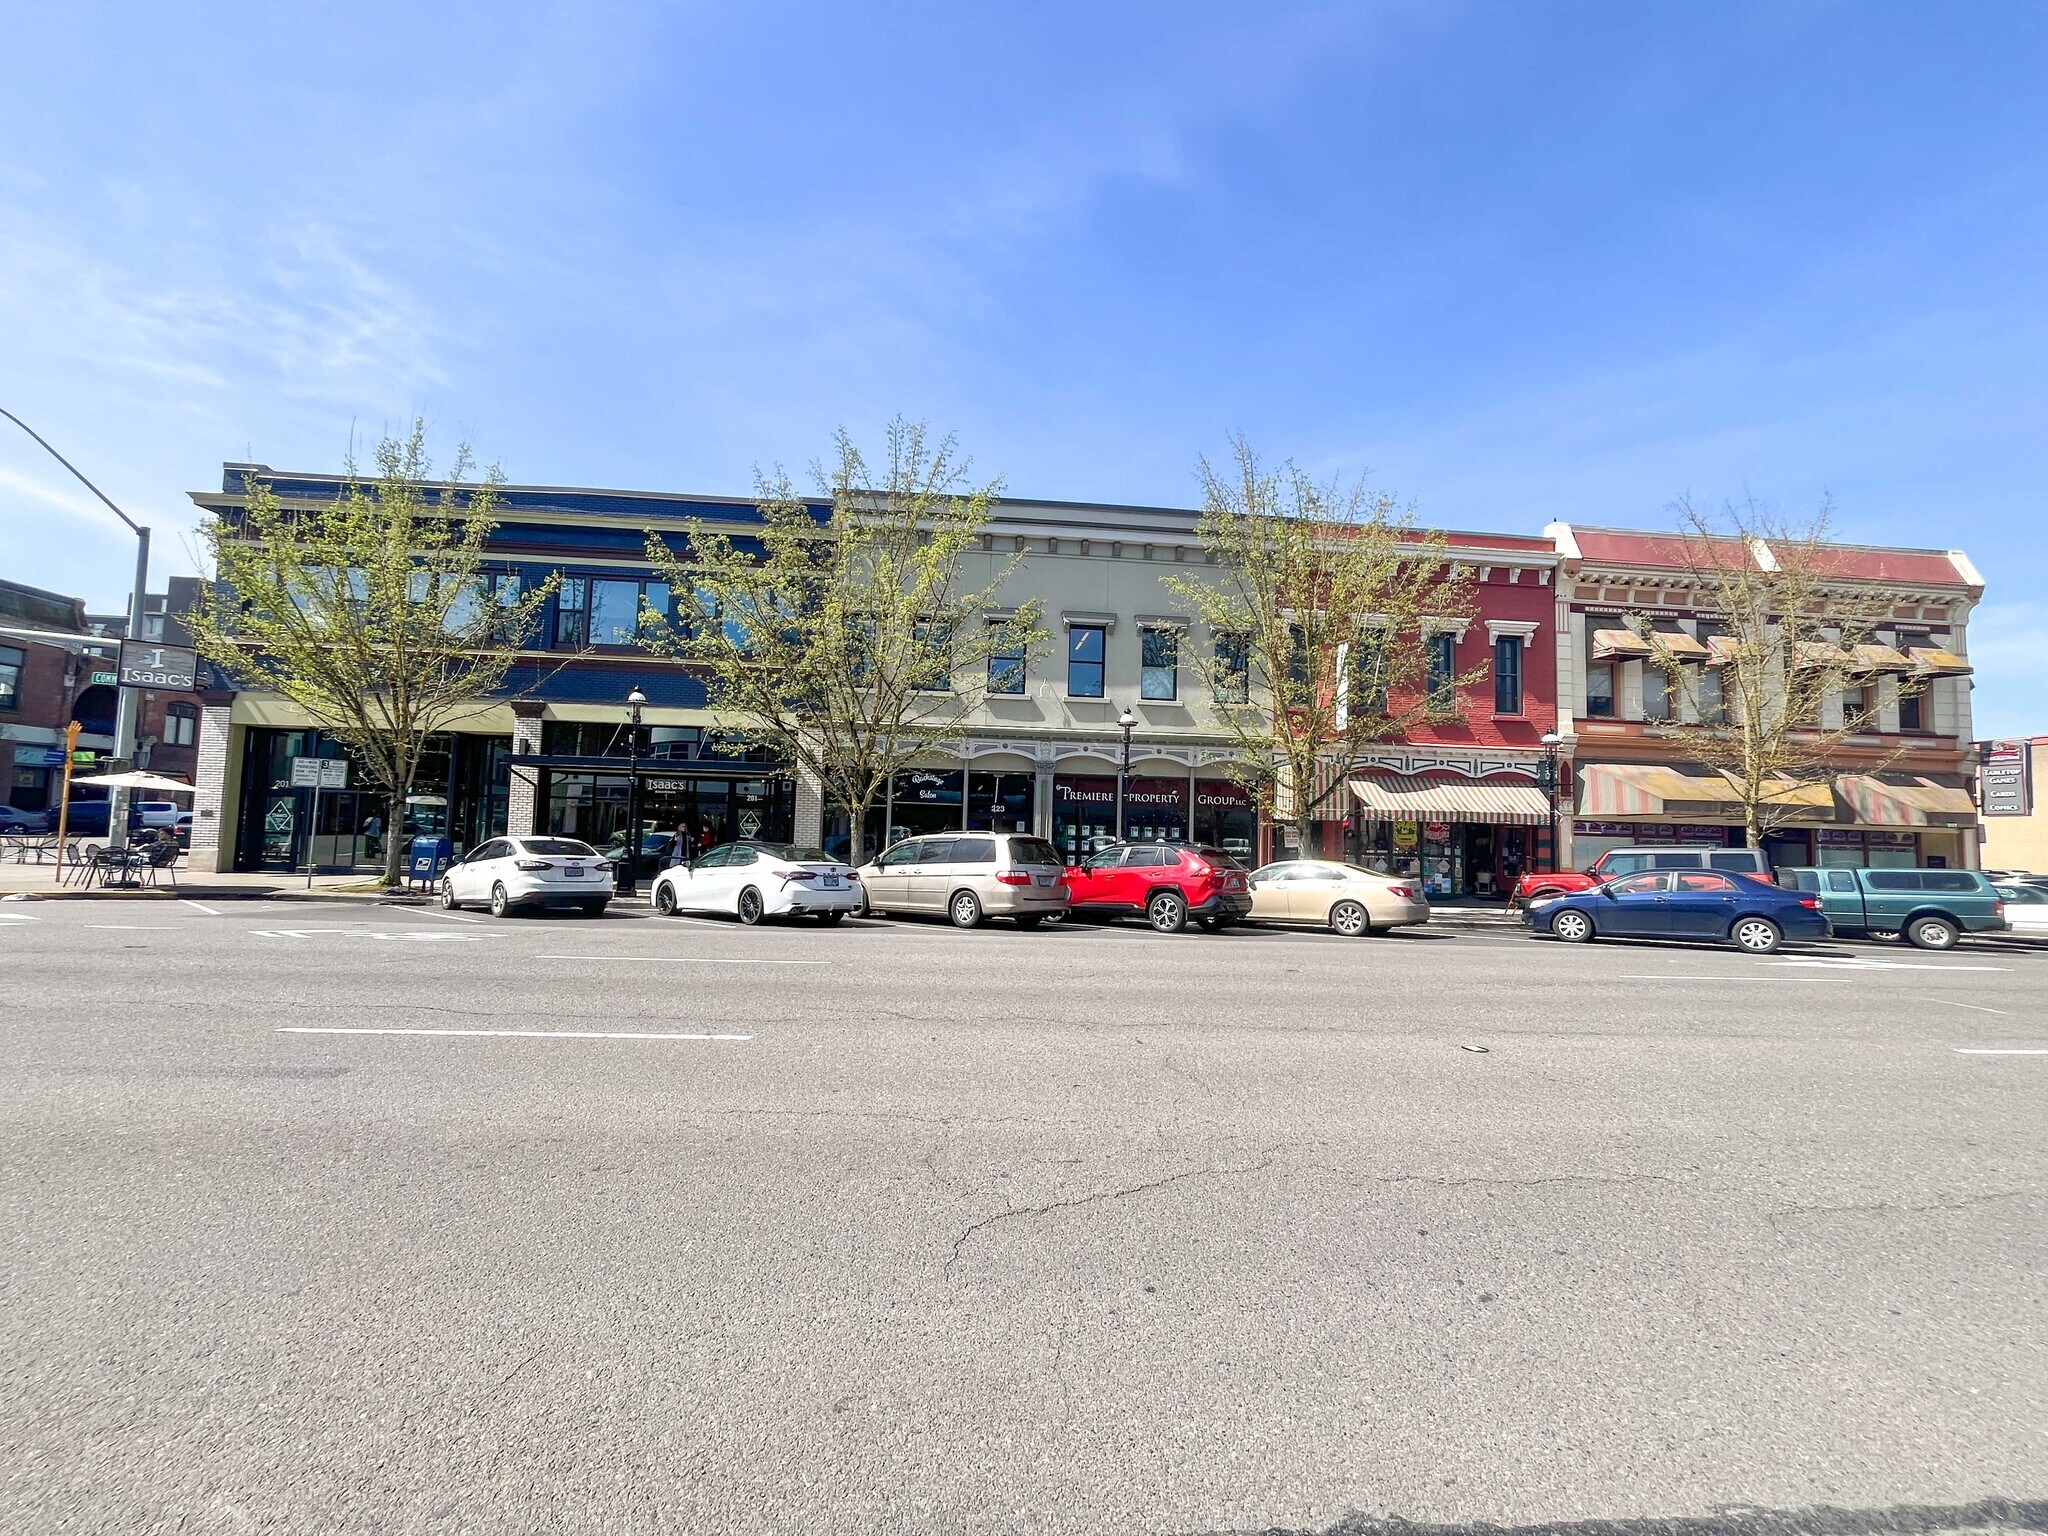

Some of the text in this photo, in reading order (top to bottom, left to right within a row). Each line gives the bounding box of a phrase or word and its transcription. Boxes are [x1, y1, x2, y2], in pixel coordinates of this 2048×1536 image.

[121, 667, 193, 687] Isaac's
[275, 780, 290, 788] 201
[647, 780, 685, 791] Isaac's
[919, 789, 937, 799] Salon
[1056, 784, 1114, 802] PREMIERE
[1129, 792, 1180, 804] PROPERTY
[1989, 790, 2016, 798] CARDS
